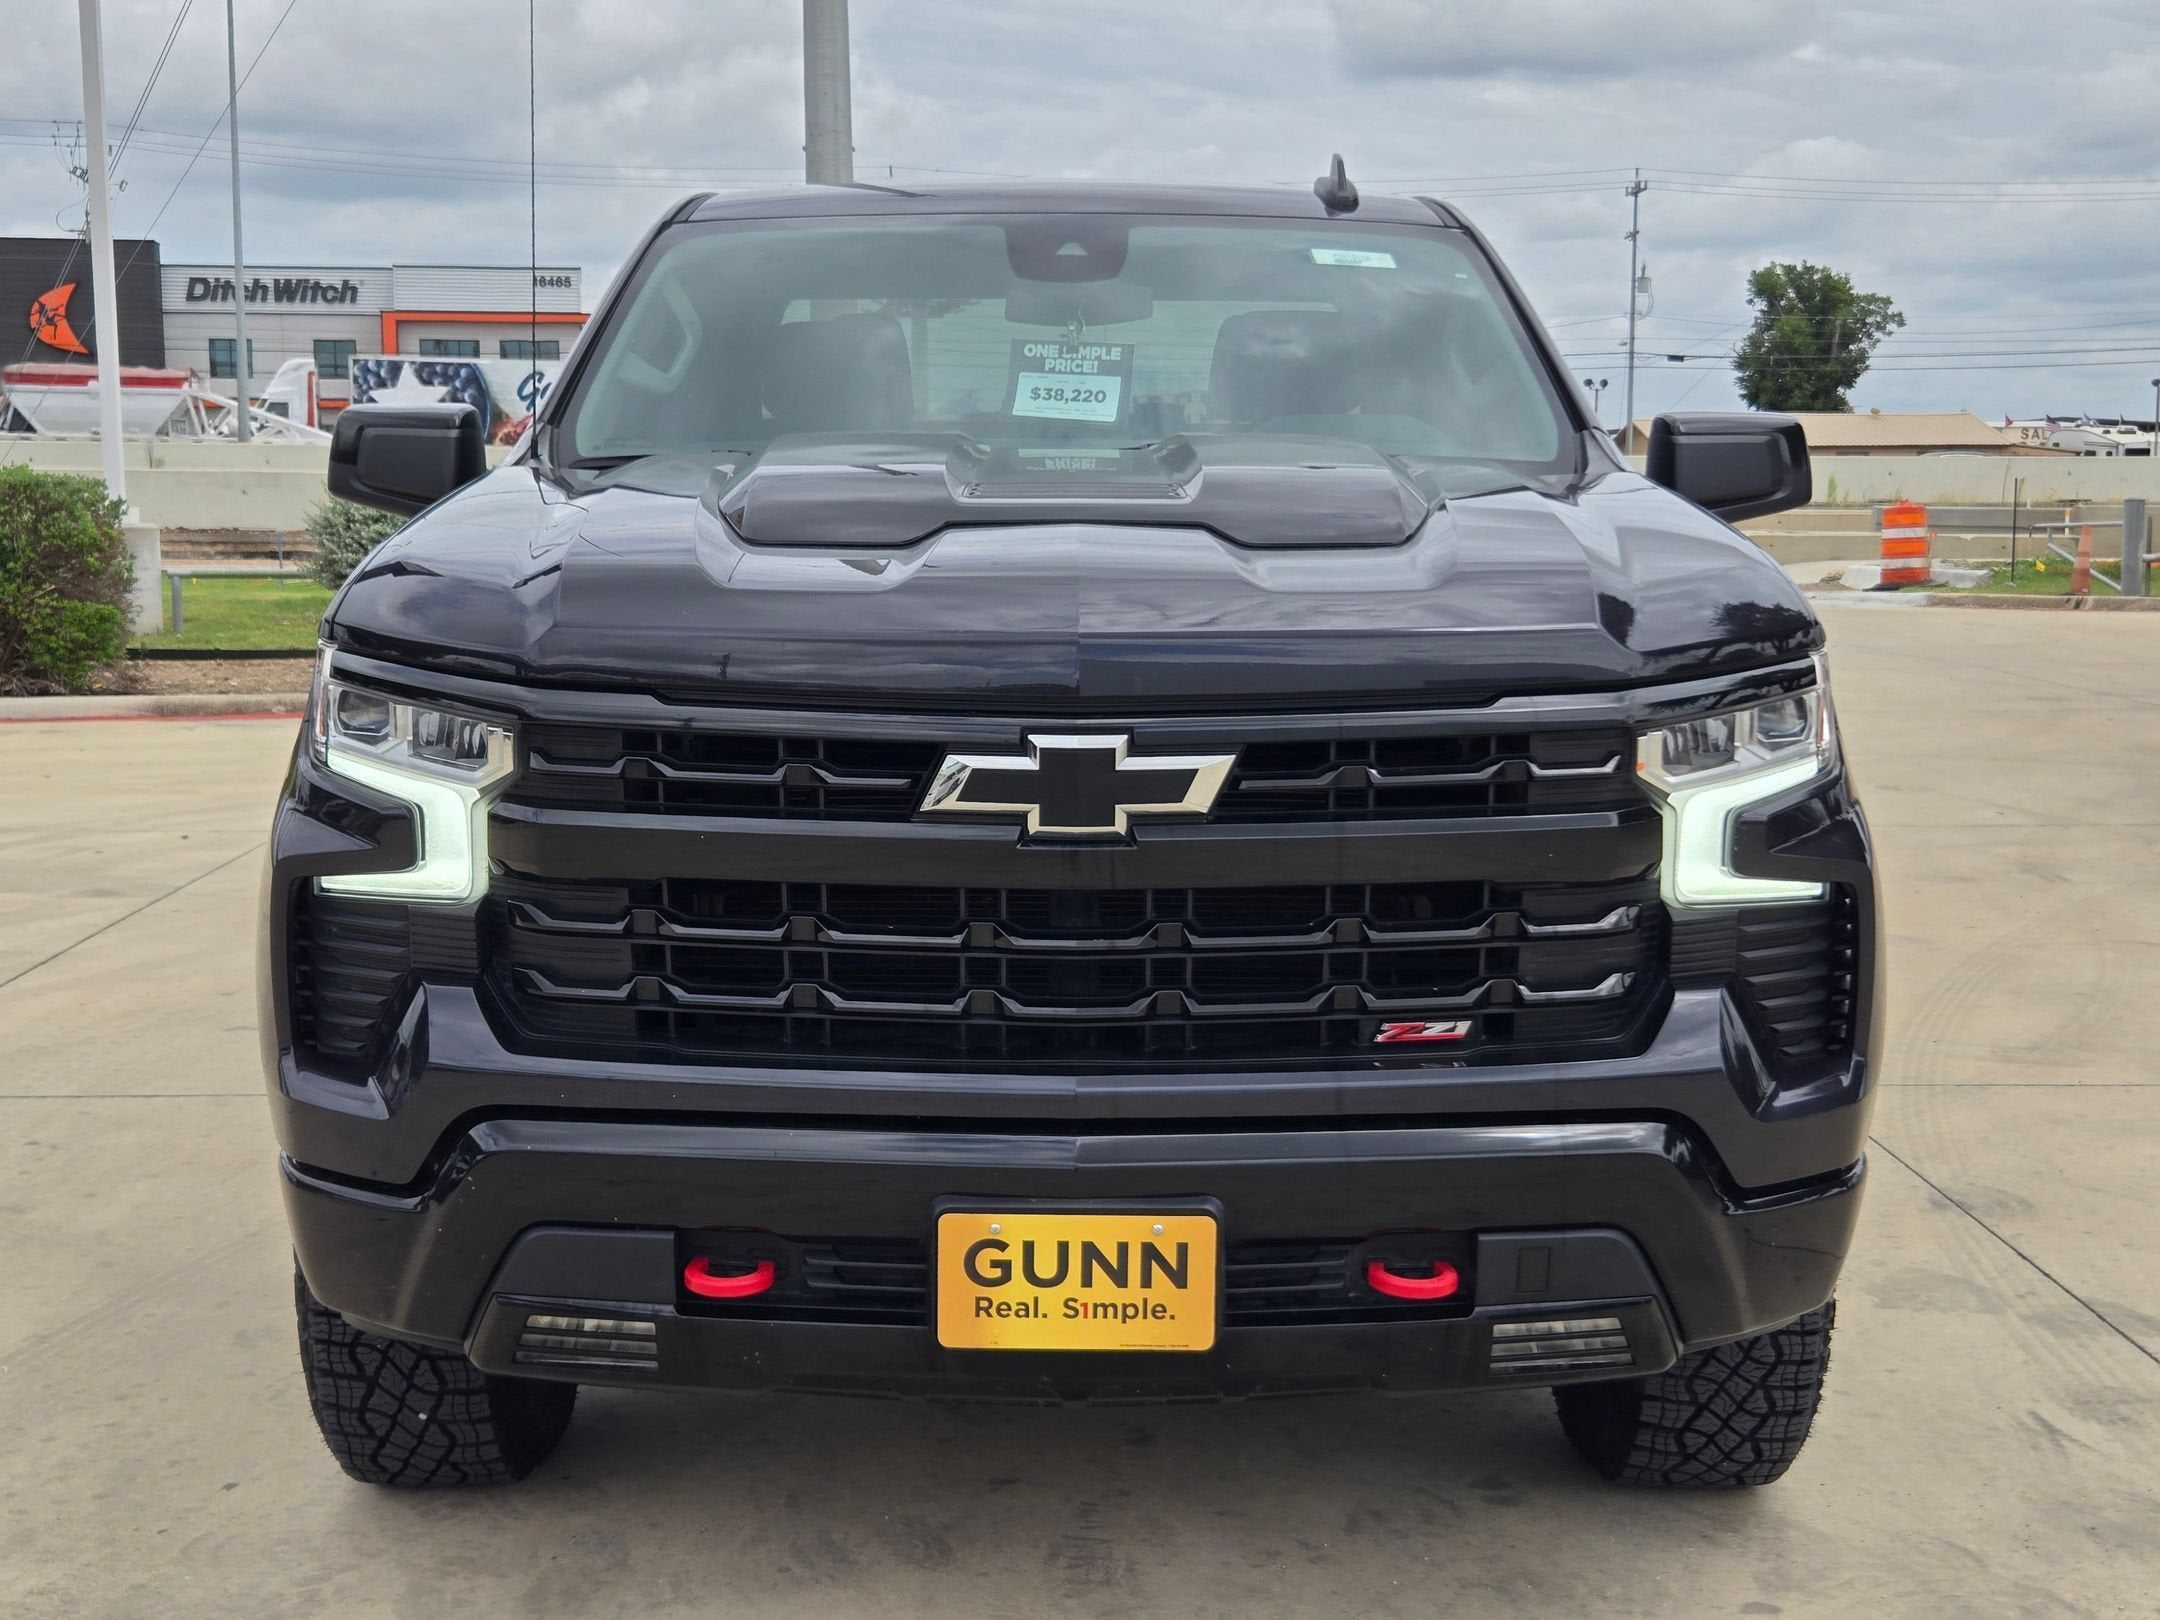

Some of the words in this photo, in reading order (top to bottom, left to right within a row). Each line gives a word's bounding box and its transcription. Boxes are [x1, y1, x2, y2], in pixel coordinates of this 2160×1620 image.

[273, 278, 359, 304] Witch
[1024, 344, 1059, 358] ONE
[1044, 359, 1099, 373] PRICE!
[1030, 387, 1107, 404] $38,220
[963, 1238, 1189, 1289] GUNN
[974, 1296, 1048, 1319] Real.
